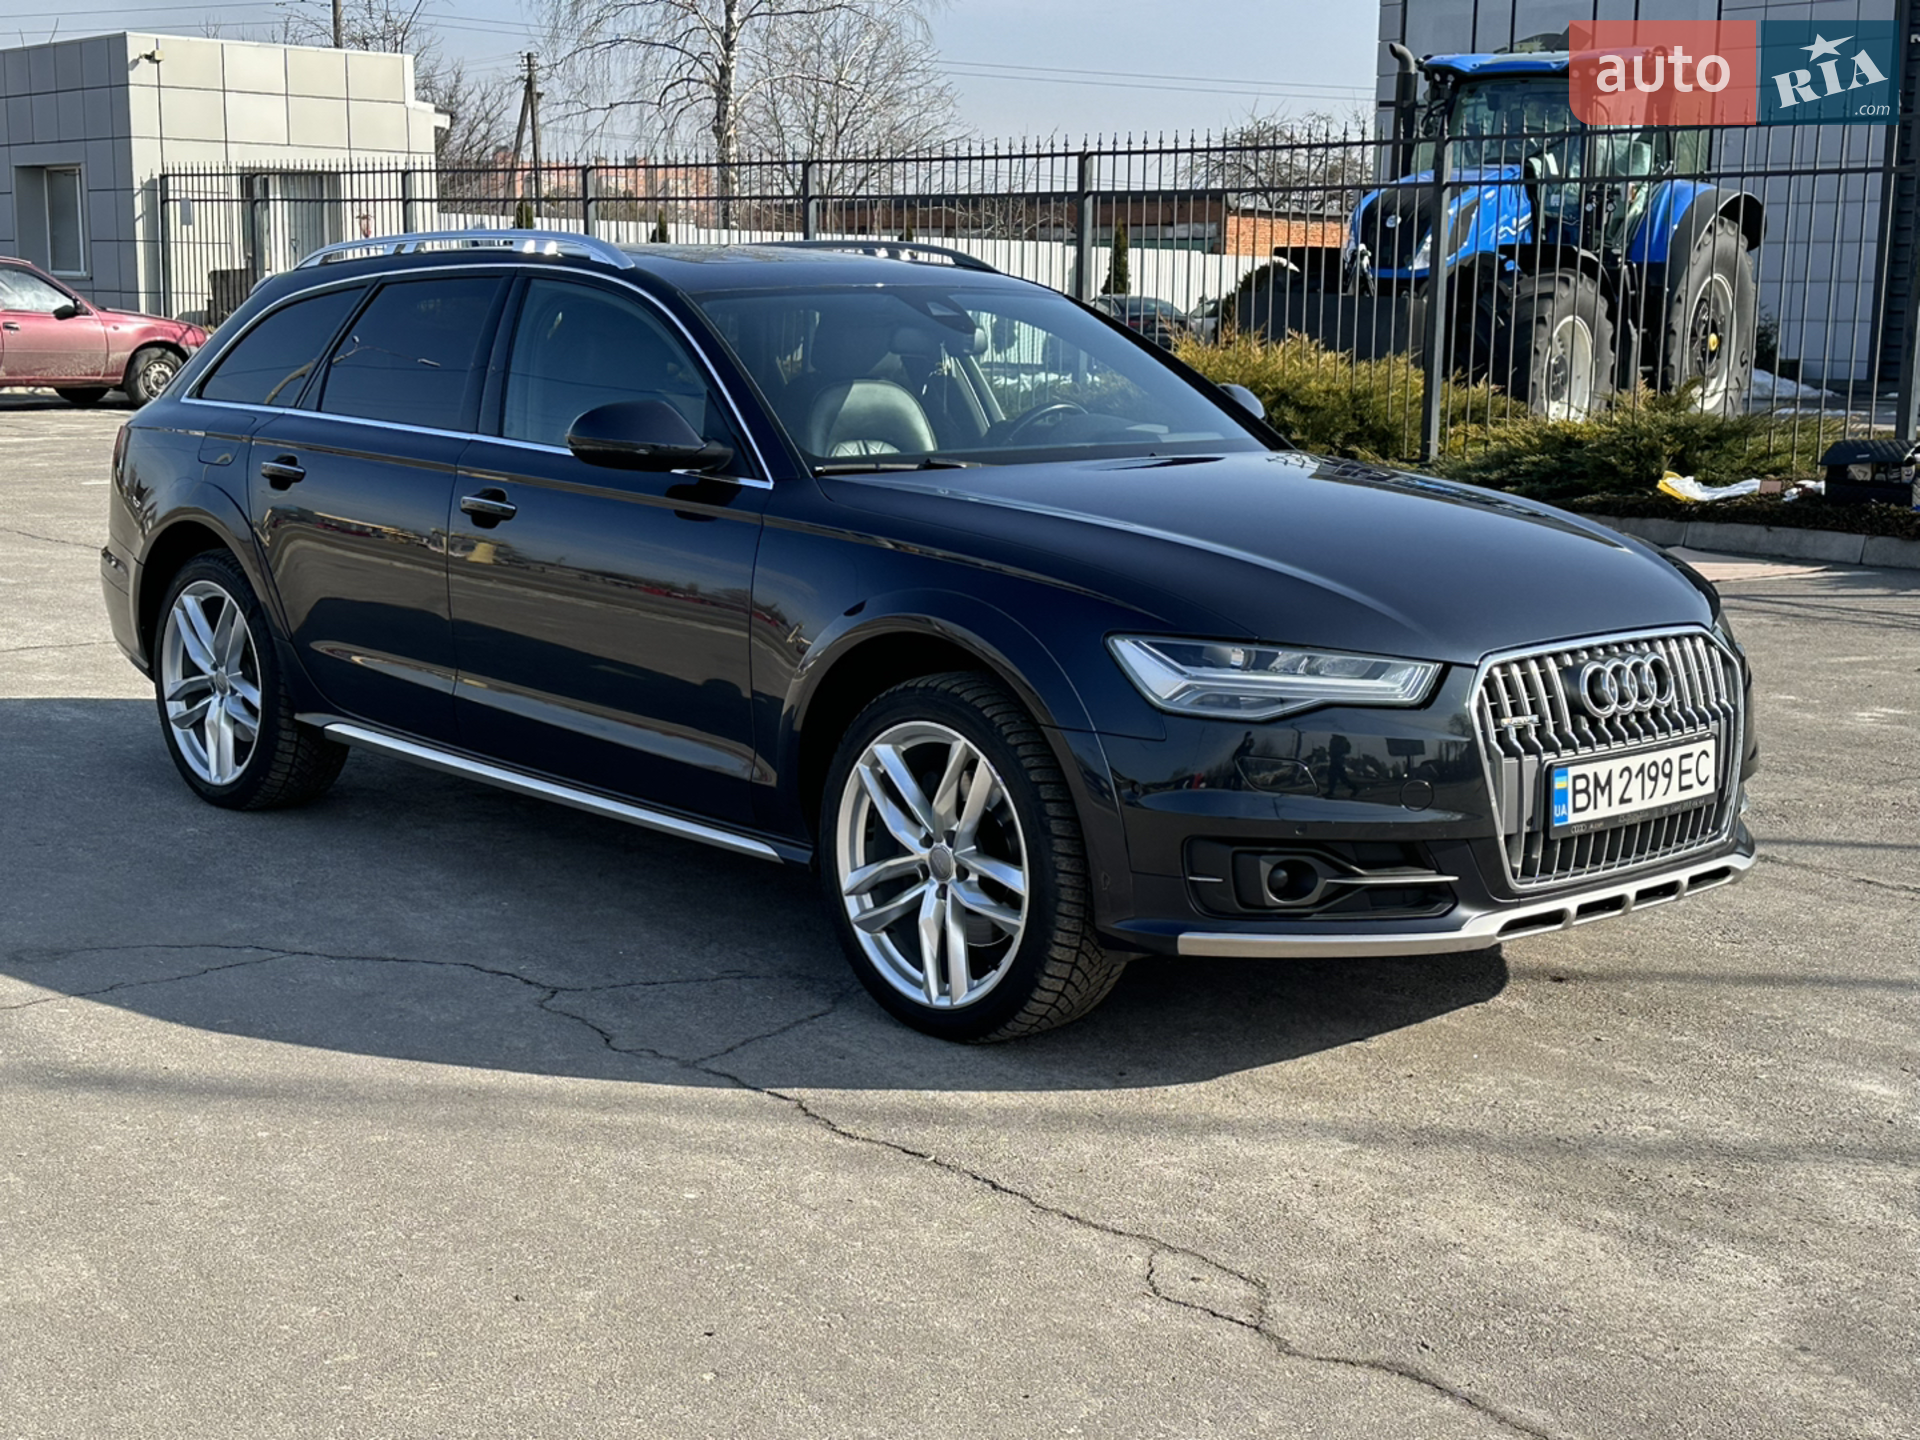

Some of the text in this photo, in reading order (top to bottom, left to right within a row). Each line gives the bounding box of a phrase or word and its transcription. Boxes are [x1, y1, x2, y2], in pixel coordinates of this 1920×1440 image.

[1572, 749, 1710, 814] BM 2199 EC
[1554, 804, 1568, 817] UA
